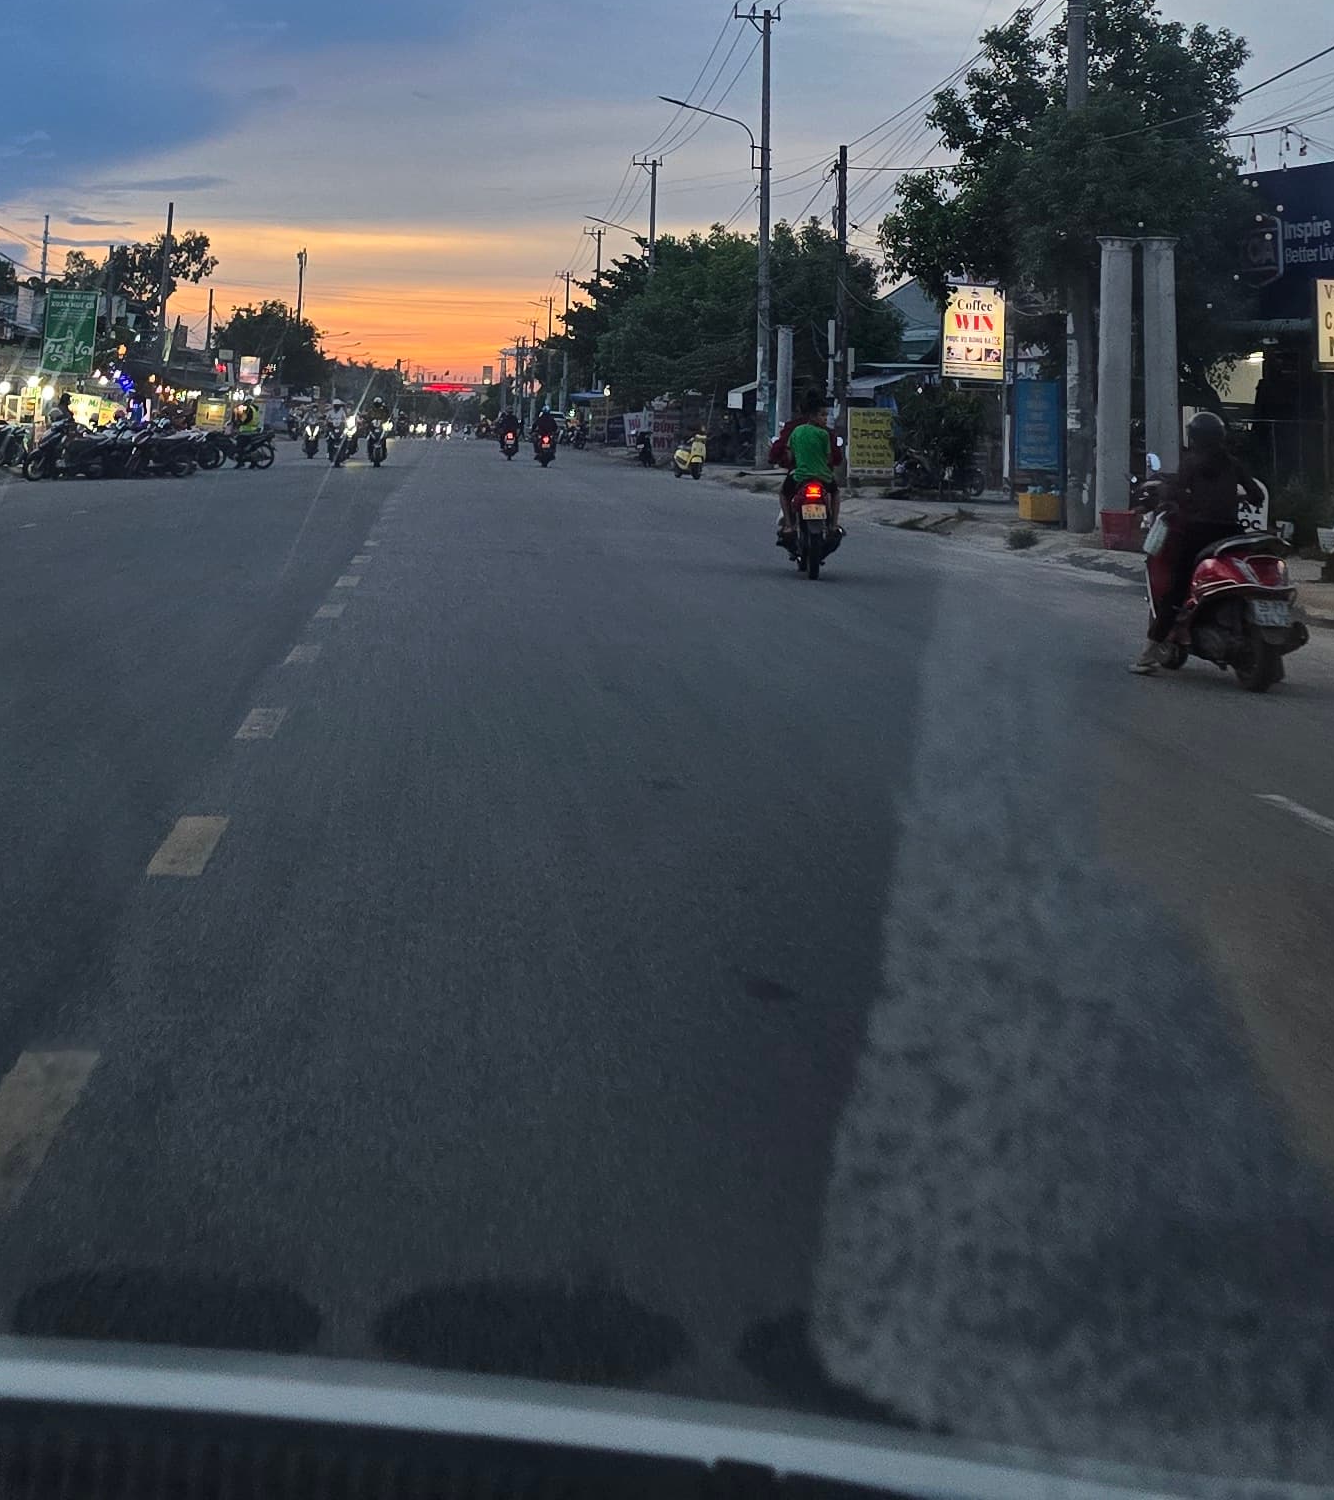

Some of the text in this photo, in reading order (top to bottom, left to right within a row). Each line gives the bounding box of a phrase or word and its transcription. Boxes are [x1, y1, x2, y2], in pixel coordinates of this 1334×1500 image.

[1284, 216, 1332, 244] Inspire
[1285, 248, 1317, 265] Better
[957, 299, 993, 312] Coffee
[955, 314, 994, 331] WIN
